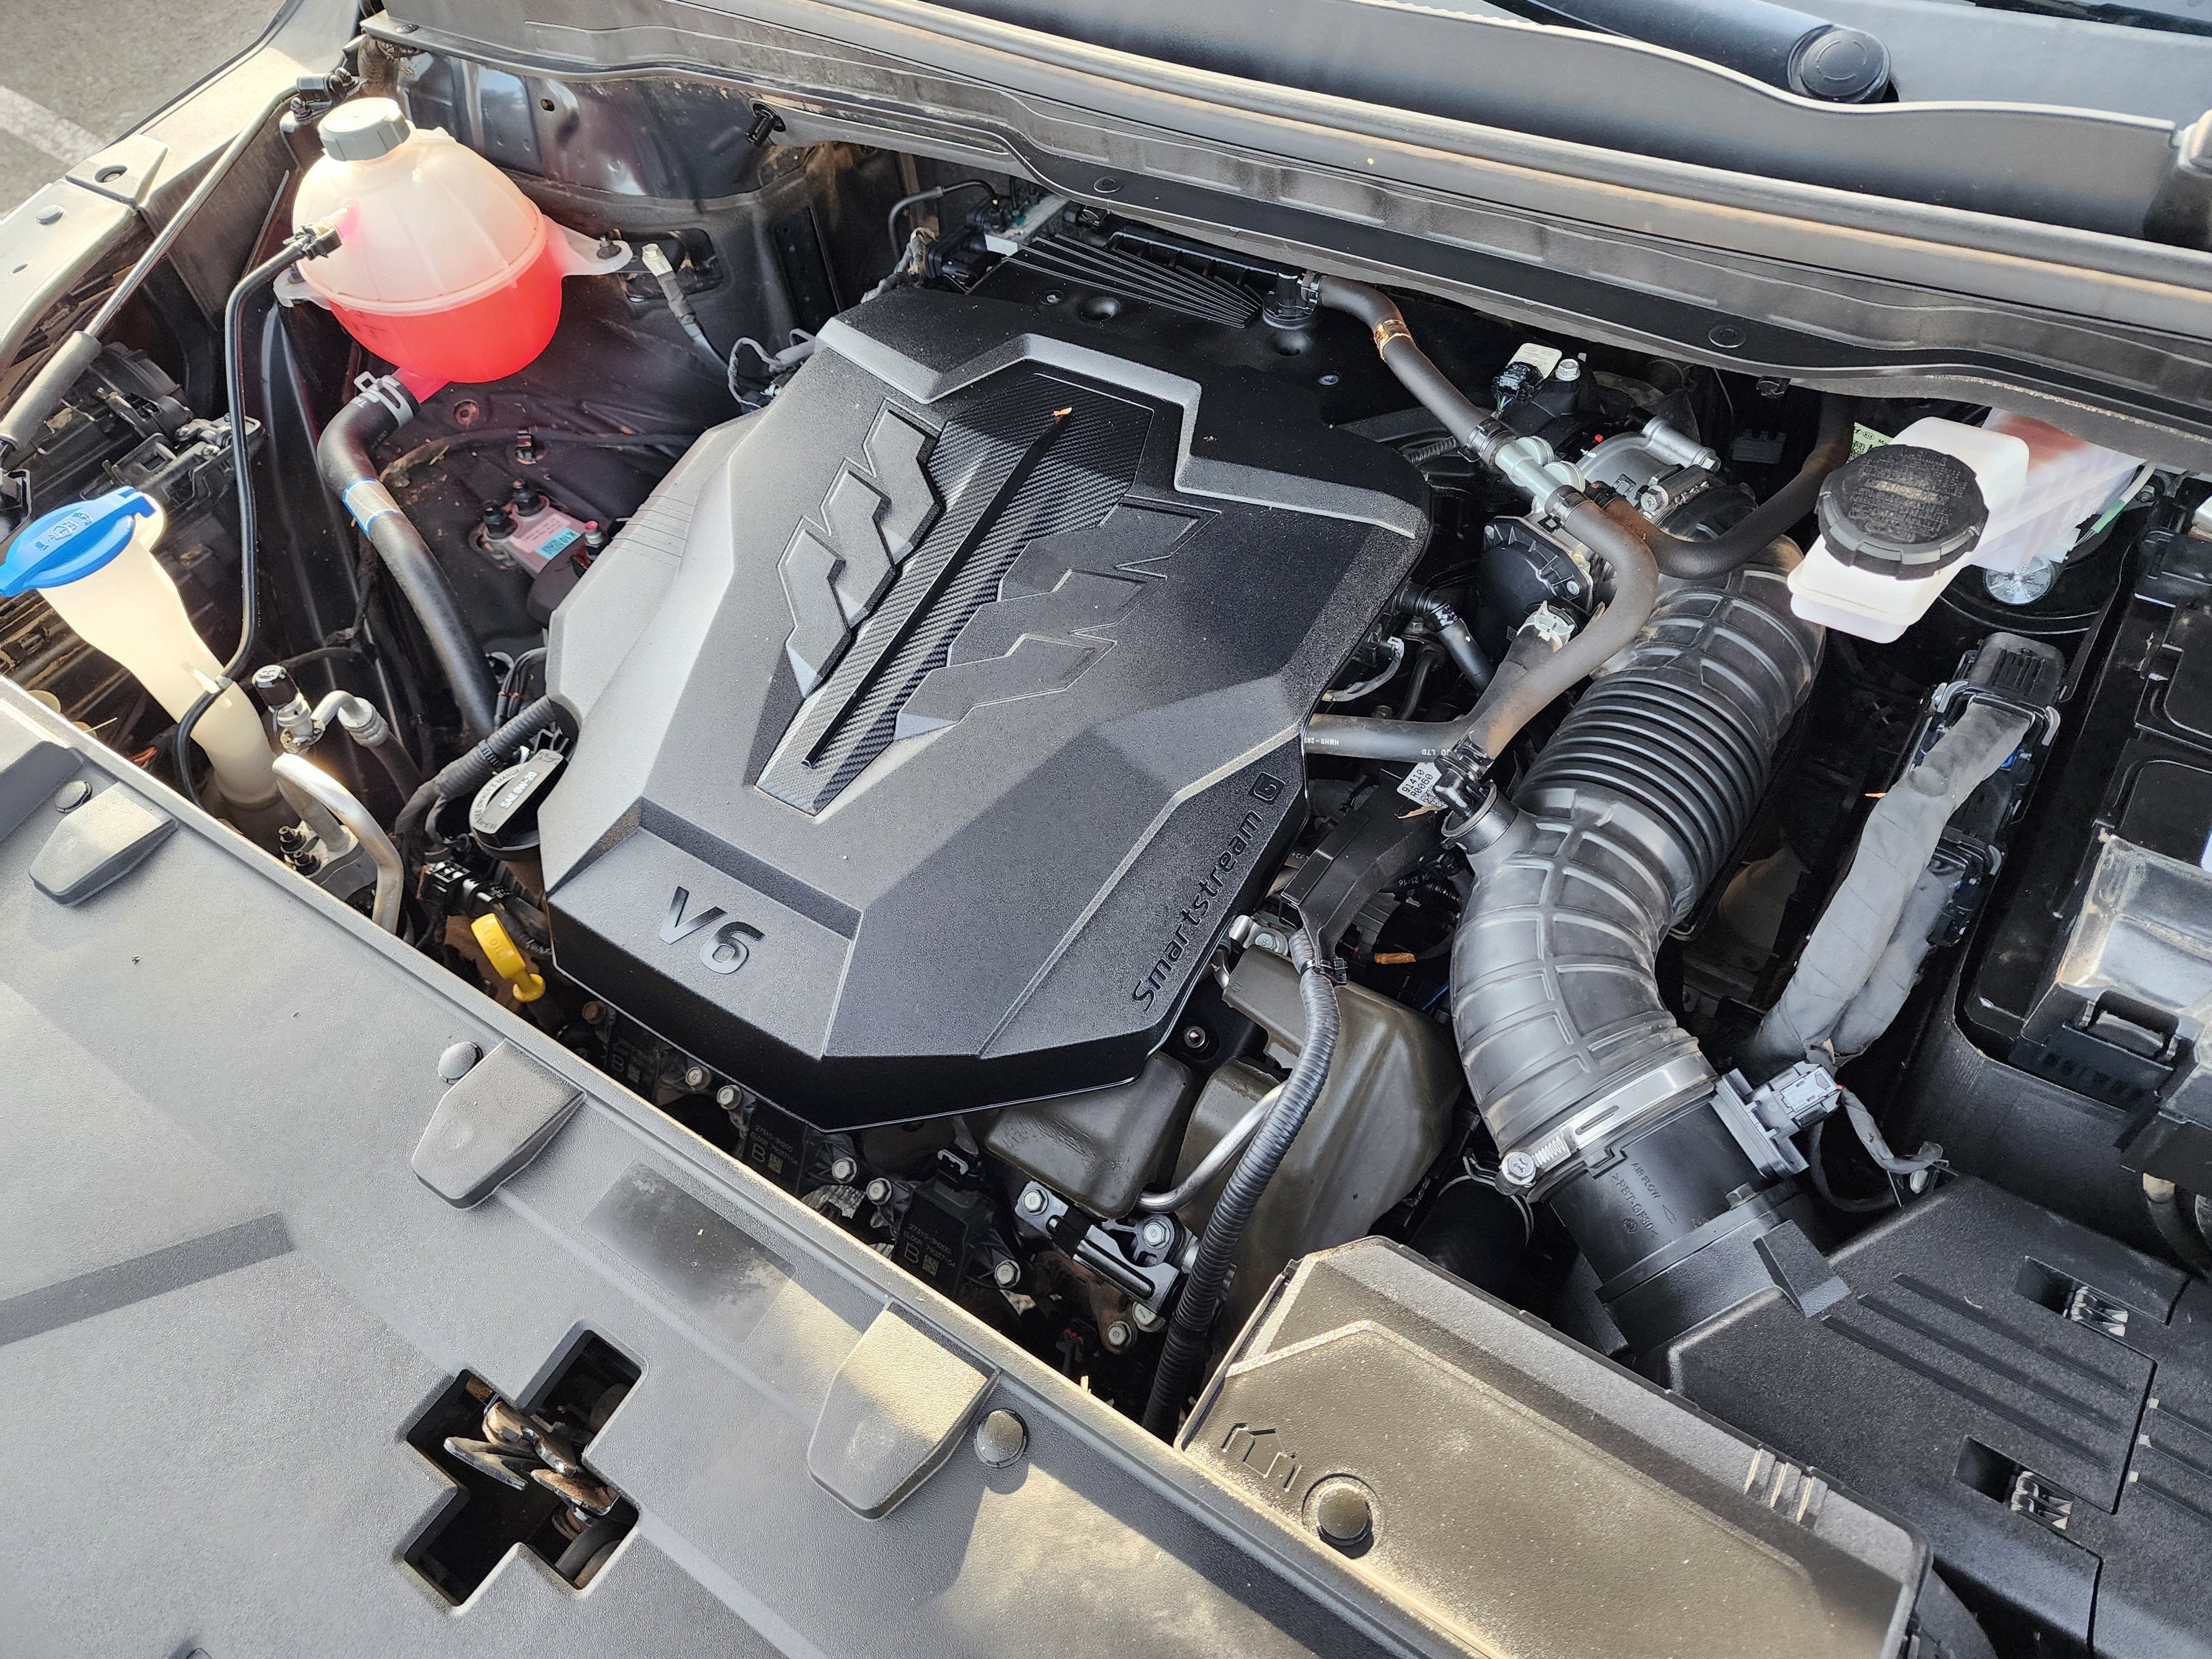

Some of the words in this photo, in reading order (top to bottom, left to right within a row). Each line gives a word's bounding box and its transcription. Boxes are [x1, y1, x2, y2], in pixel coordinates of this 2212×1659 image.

[1401, 769, 1425, 793] 91410
[1410, 773, 1433, 798] R0060
[499, 791, 519, 810] SAE
[1132, 810, 1263, 1013] Smartstream
[1251, 774, 1282, 802] G
[660, 886, 766, 975] V6
[752, 1142, 766, 1162] B
[1631, 1162, 1645, 1177] AIR
[1641, 1175, 1662, 1199] FLOW
[904, 1242, 920, 1263] B
